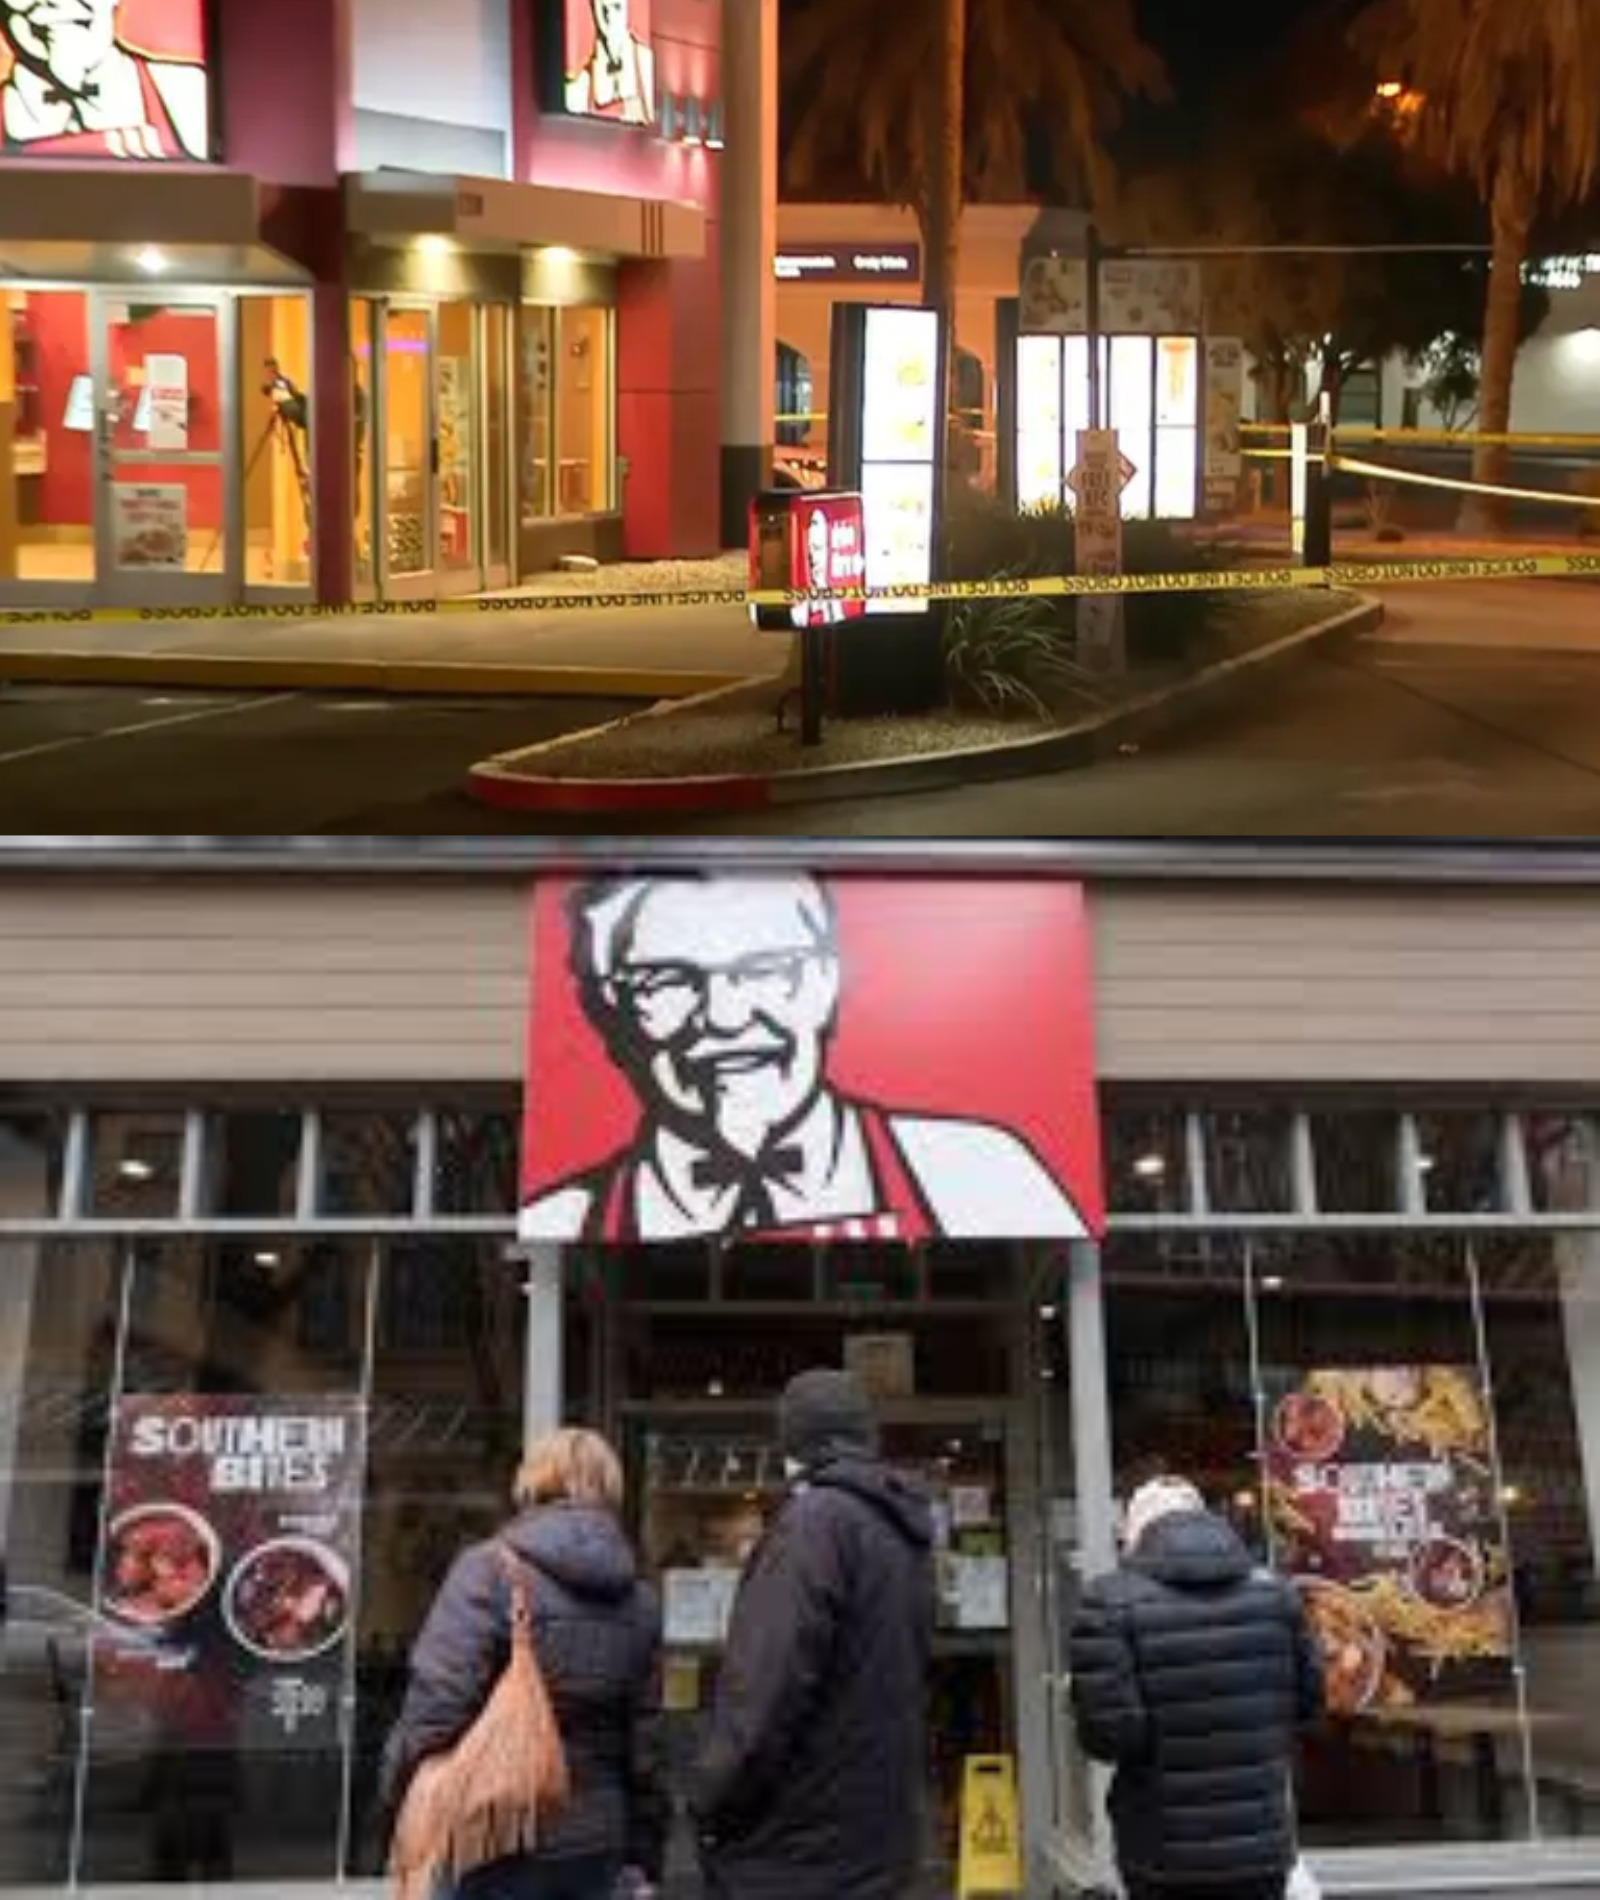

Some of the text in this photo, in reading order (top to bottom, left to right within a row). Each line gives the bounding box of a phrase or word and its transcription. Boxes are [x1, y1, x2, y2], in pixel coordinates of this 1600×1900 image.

[1064, 570, 1292, 592] POLICE LINE DO NOT CROSS
[1322, 558, 1538, 583] POLICE LINE DO NOT CROSS
[478, 589, 745, 611] POLICE LINE DO NOT CROSS
[783, 579, 1031, 601] POLICE LINE DO NOT CROSS
[208, 1454, 328, 1491] BITES
